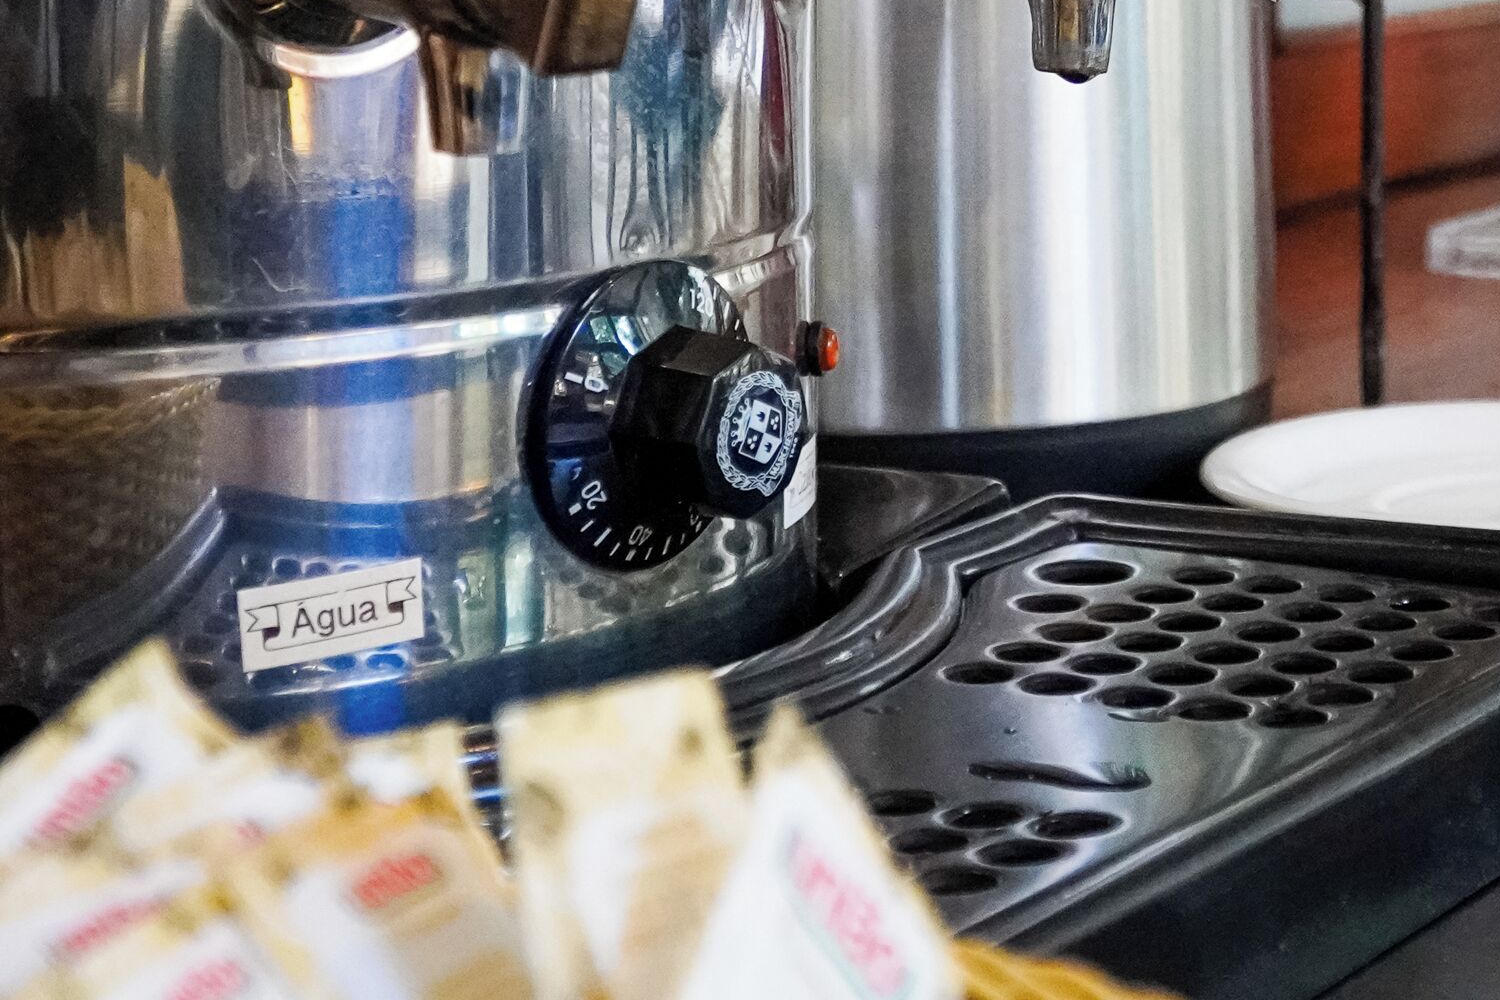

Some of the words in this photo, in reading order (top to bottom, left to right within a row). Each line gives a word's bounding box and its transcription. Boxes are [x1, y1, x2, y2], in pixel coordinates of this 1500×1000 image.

[689, 288, 714, 317] 120
[581, 480, 607, 510] 20
[628, 525, 653, 546] 40
[291, 600, 378, 638] Água
